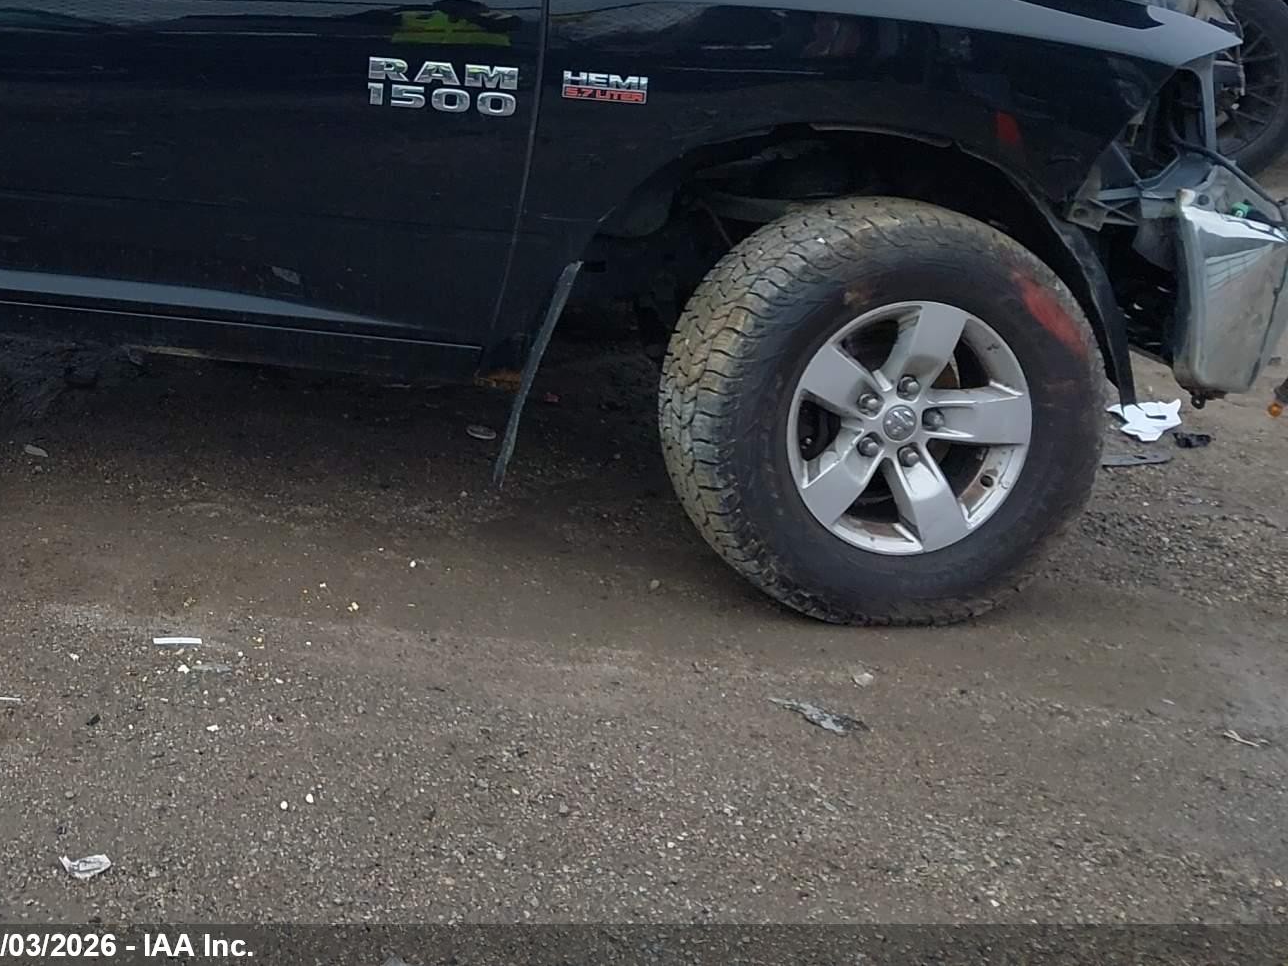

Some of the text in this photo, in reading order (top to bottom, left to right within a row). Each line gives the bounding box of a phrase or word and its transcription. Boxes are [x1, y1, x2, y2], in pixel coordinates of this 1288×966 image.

[369, 57, 519, 90] RAM
[562, 69, 648, 91] HEMI
[367, 83, 518, 117] 1500
[565, 86, 643, 102] 5.7 LITER
